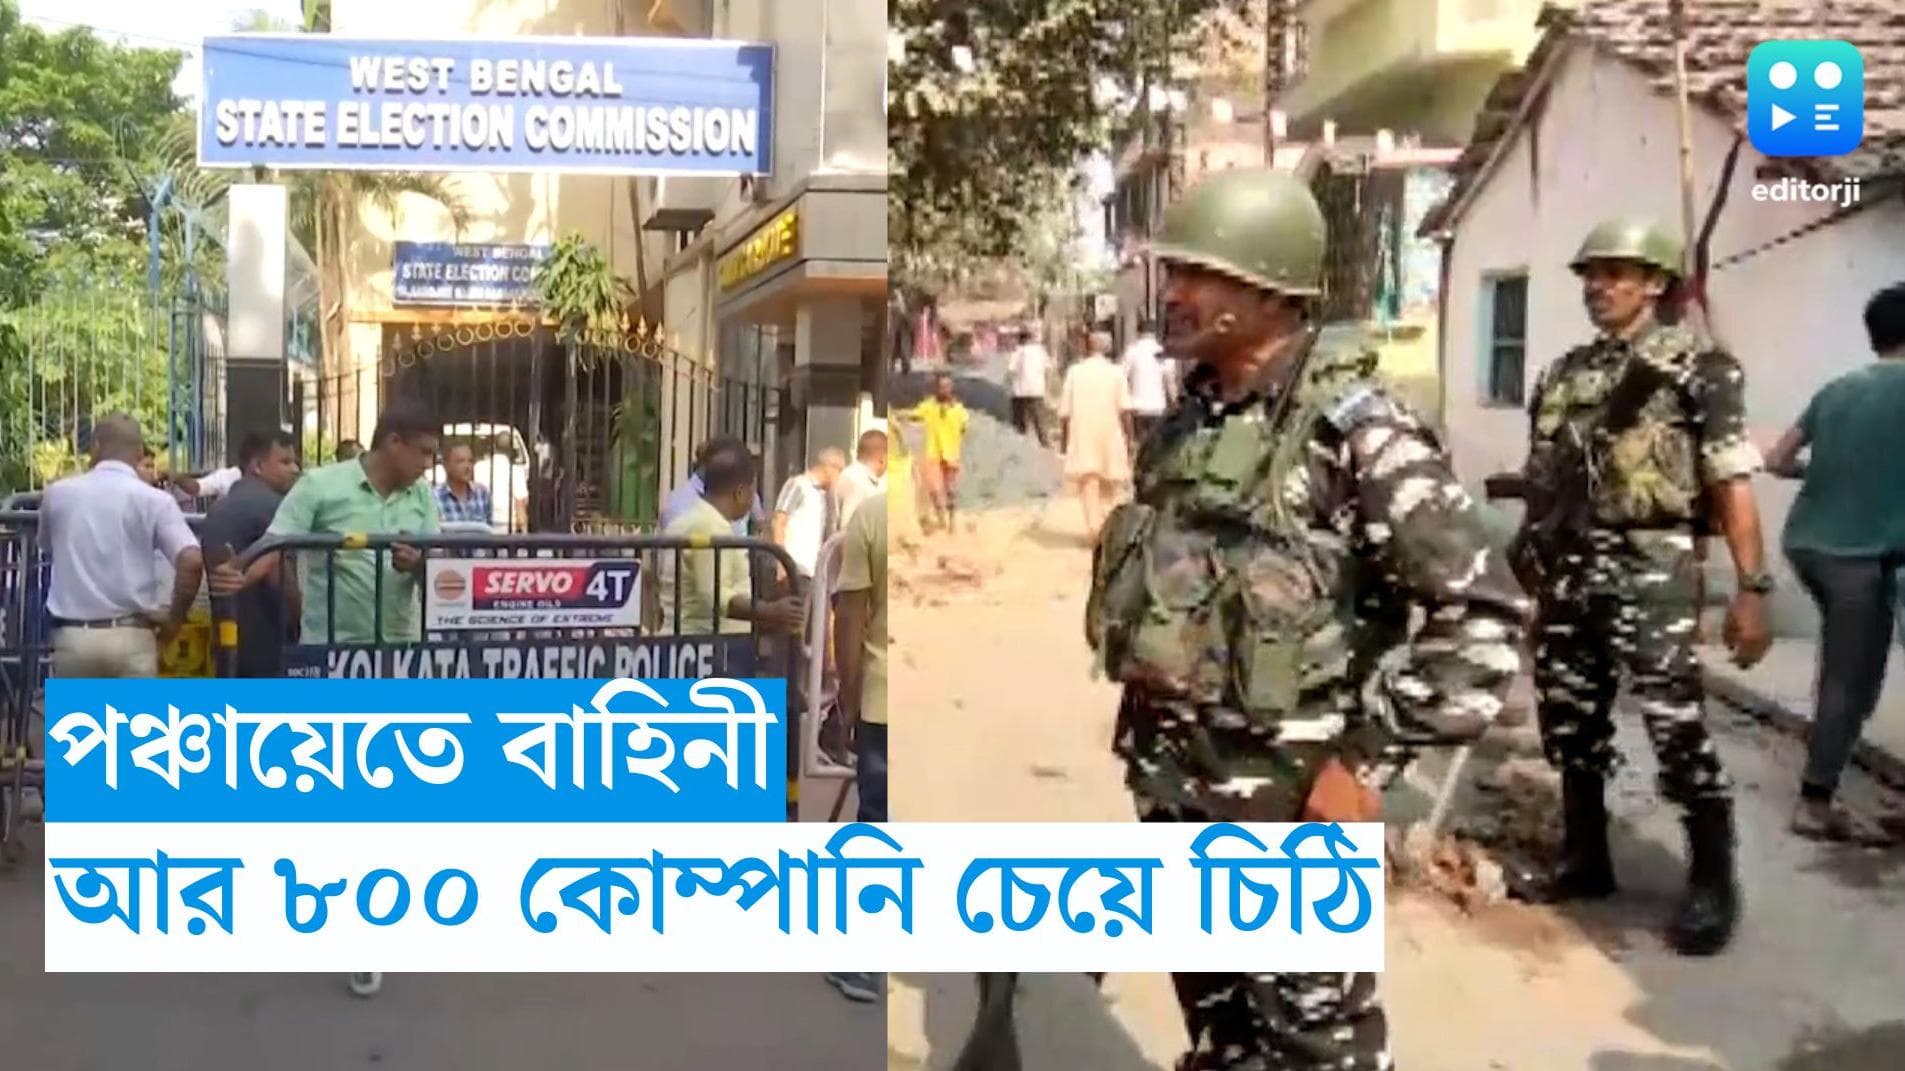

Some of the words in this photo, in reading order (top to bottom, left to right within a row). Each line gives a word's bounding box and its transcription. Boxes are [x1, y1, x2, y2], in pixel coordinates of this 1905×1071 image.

[350, 56, 455, 94] WEST
[469, 58, 624, 99] BENGAL
[215, 99, 326, 148] STATE
[336, 101, 515, 152] ELECTION
[524, 105, 756, 156] COMMISSION
[402, 262, 441, 280] STATE
[445, 264, 508, 282] ELECTION
[484, 570, 573, 594] SERVO
[585, 569, 631, 603] 4T
[437, 615, 464, 625] THE
[468, 615, 525, 625] SCIENCE
[530, 614, 547, 623] OF
[327, 648, 471, 679] KOLKATA
[482, 647, 606, 679] TRAFFIC
[614, 642, 714, 679] POLICE
